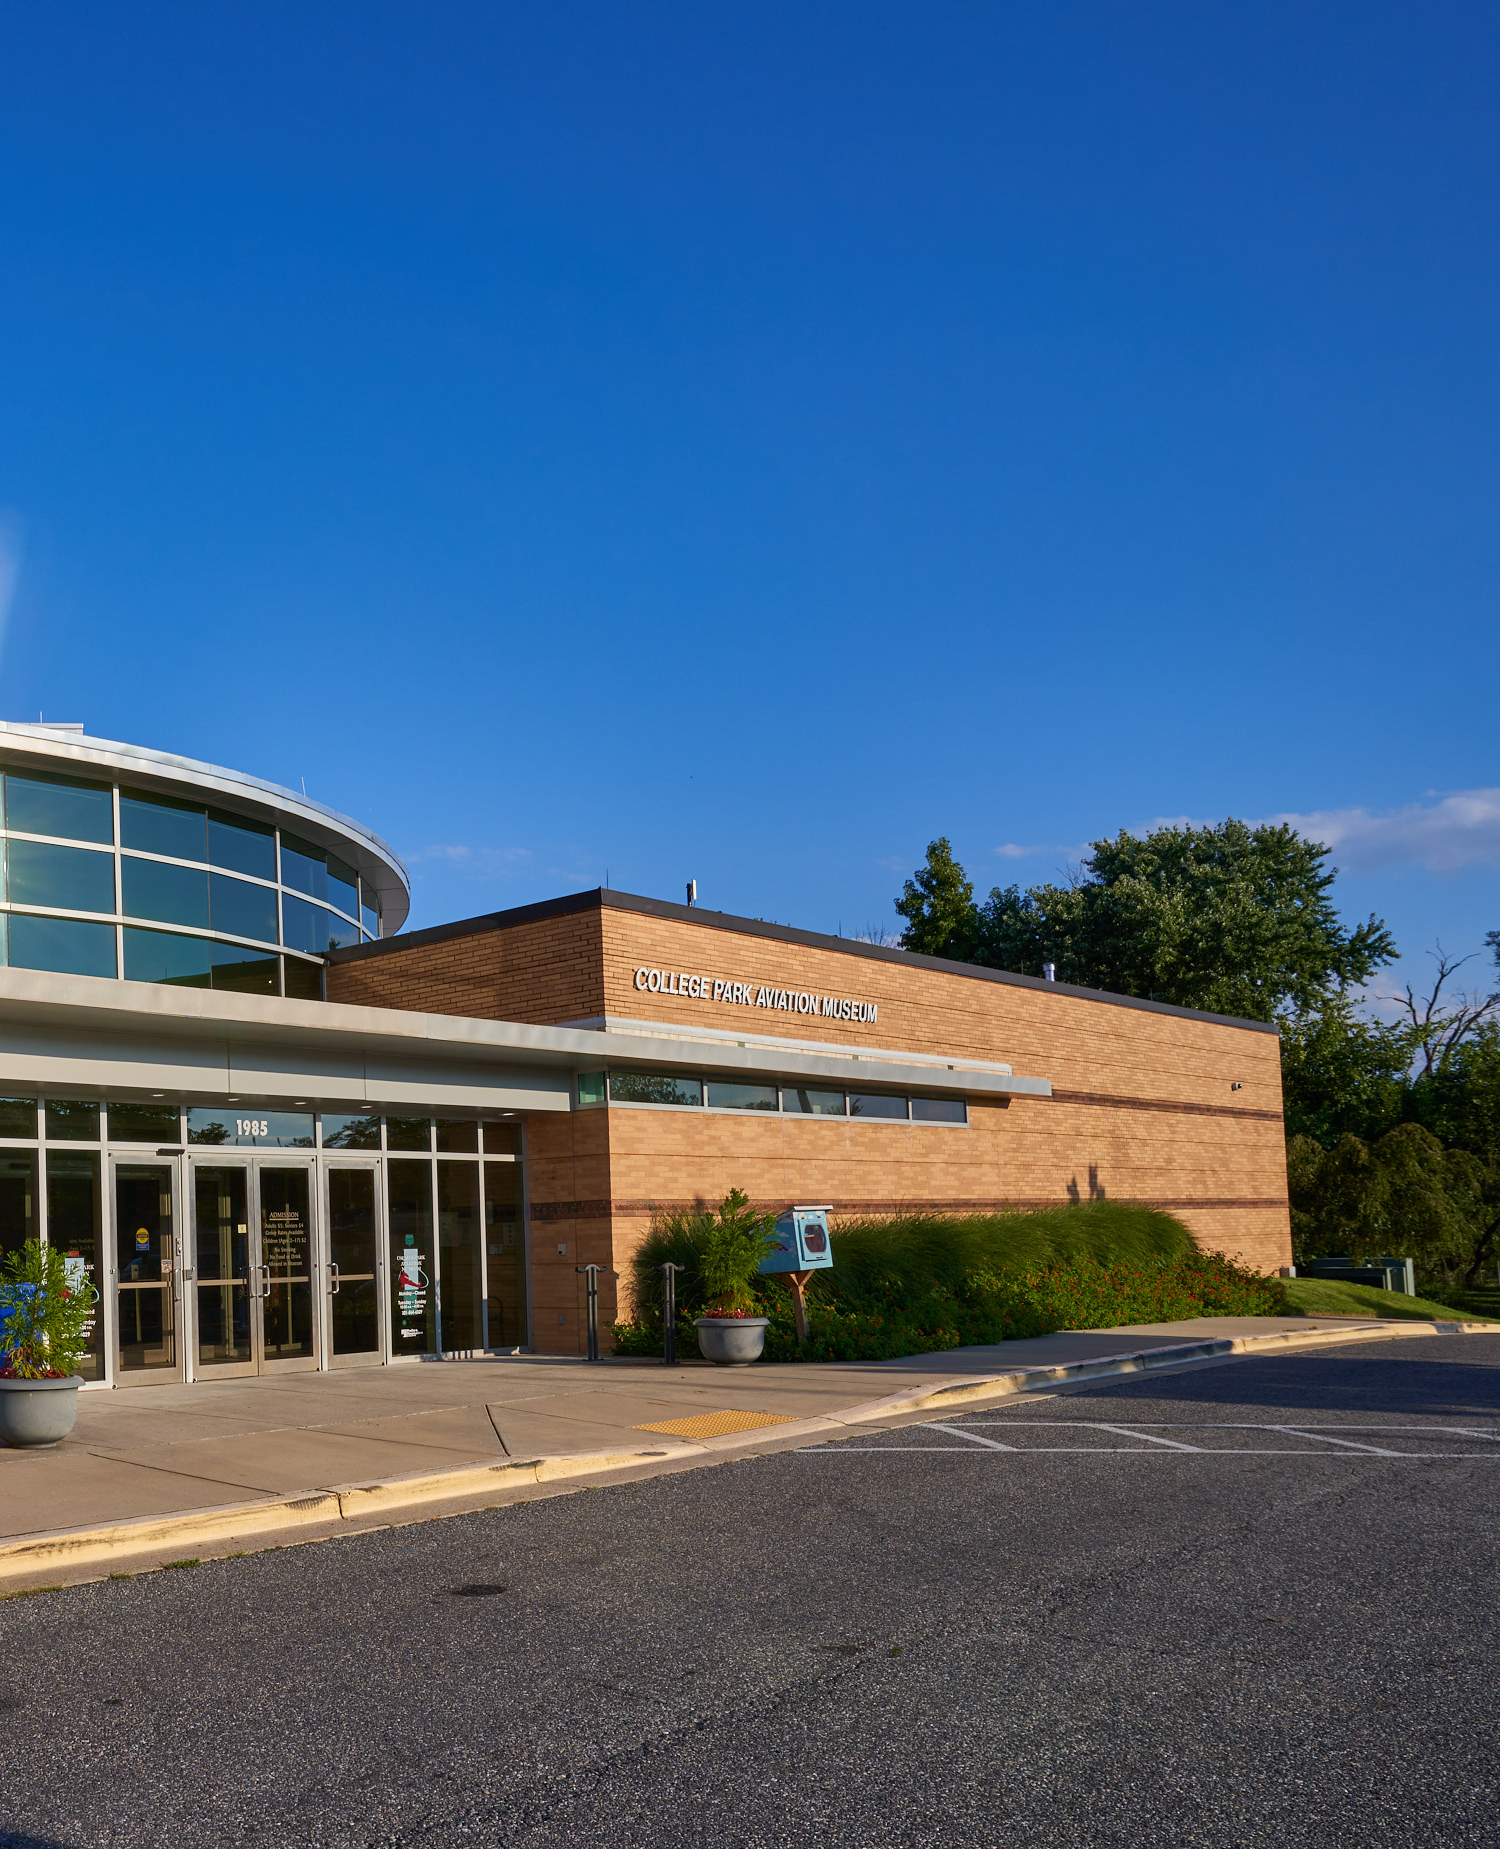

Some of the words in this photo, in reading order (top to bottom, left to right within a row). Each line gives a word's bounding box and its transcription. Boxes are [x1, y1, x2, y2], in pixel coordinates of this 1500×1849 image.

[635, 967, 710, 998] COLLEGE
[713, 979, 753, 1005] PARK
[755, 987, 818, 1015] AVIATION
[820, 997, 878, 1023] MUSEUM
[236, 1119, 268, 1136] 1985
